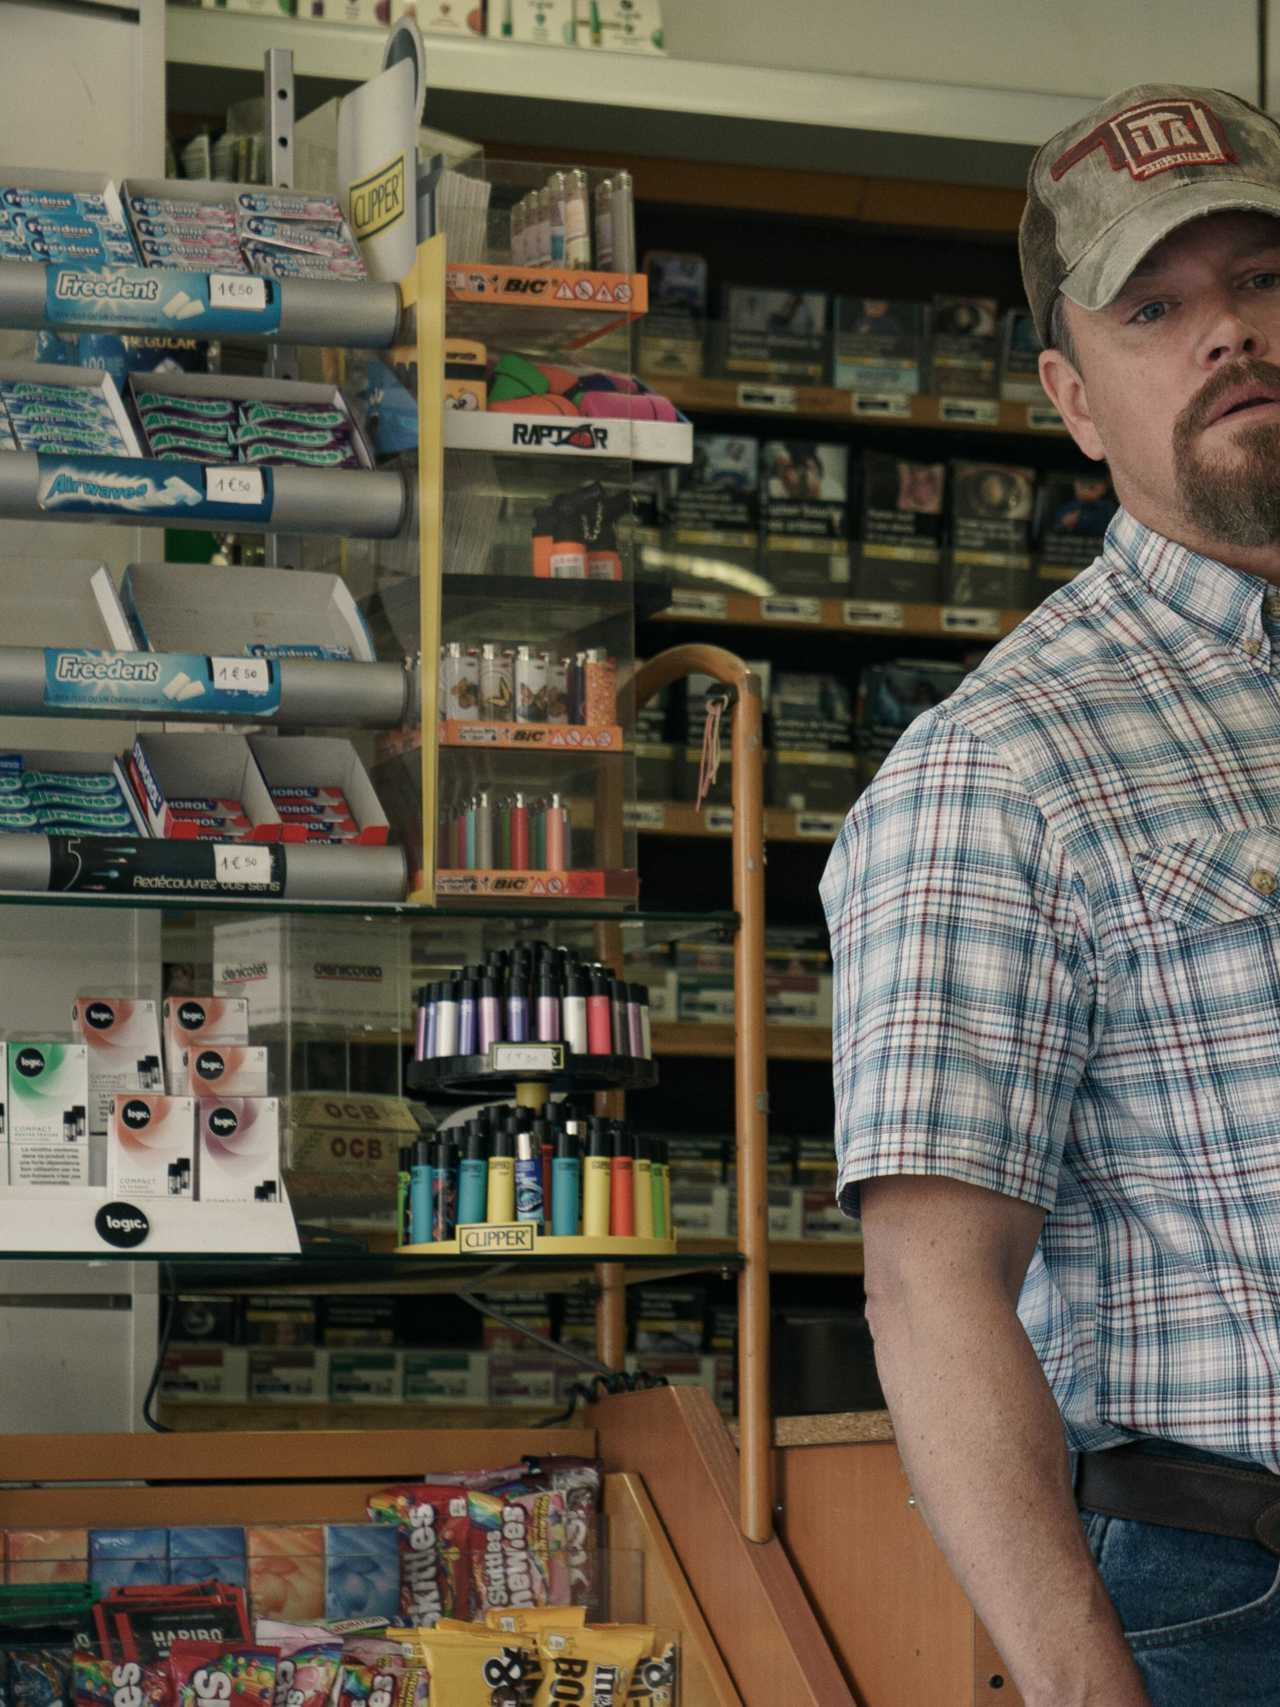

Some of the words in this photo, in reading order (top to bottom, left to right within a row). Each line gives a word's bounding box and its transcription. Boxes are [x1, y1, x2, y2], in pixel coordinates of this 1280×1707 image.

[354, 174, 399, 229] CLIPPER
[27, 221, 94, 235] Freedent
[33, 240, 100, 255] Freedent
[59, 273, 158, 300] Freedent
[504, 279, 548, 294] BIC
[138, 393, 228, 413] Airwaves
[248, 407, 341, 423] Airwaves
[238, 426, 331, 442] Airwaves
[513, 423, 607, 449] RAPTOR
[248, 445, 341, 462] Airwaves
[45, 474, 147, 500] Airwaves
[59, 656, 158, 682] Freedent
[513, 731, 544, 742] BIC
[133, 742, 162, 809] STIMOROL
[133, 874, 217, 891] Redécouvrez
[494, 878, 526, 890] BIC
[91, 1010, 113, 1022] logic.
[182, 1010, 205, 1022] logic.
[21, 1056, 44, 1070] logic.
[201, 1060, 223, 1071] logic.
[128, 1108, 150, 1121] logic.
[324, 1102, 379, 1120] OCB
[214, 1116, 237, 1128] logic.
[330, 1136, 383, 1159] OCB
[106, 1215, 147, 1232] logic.
[465, 1230, 526, 1247] CLIPPER
